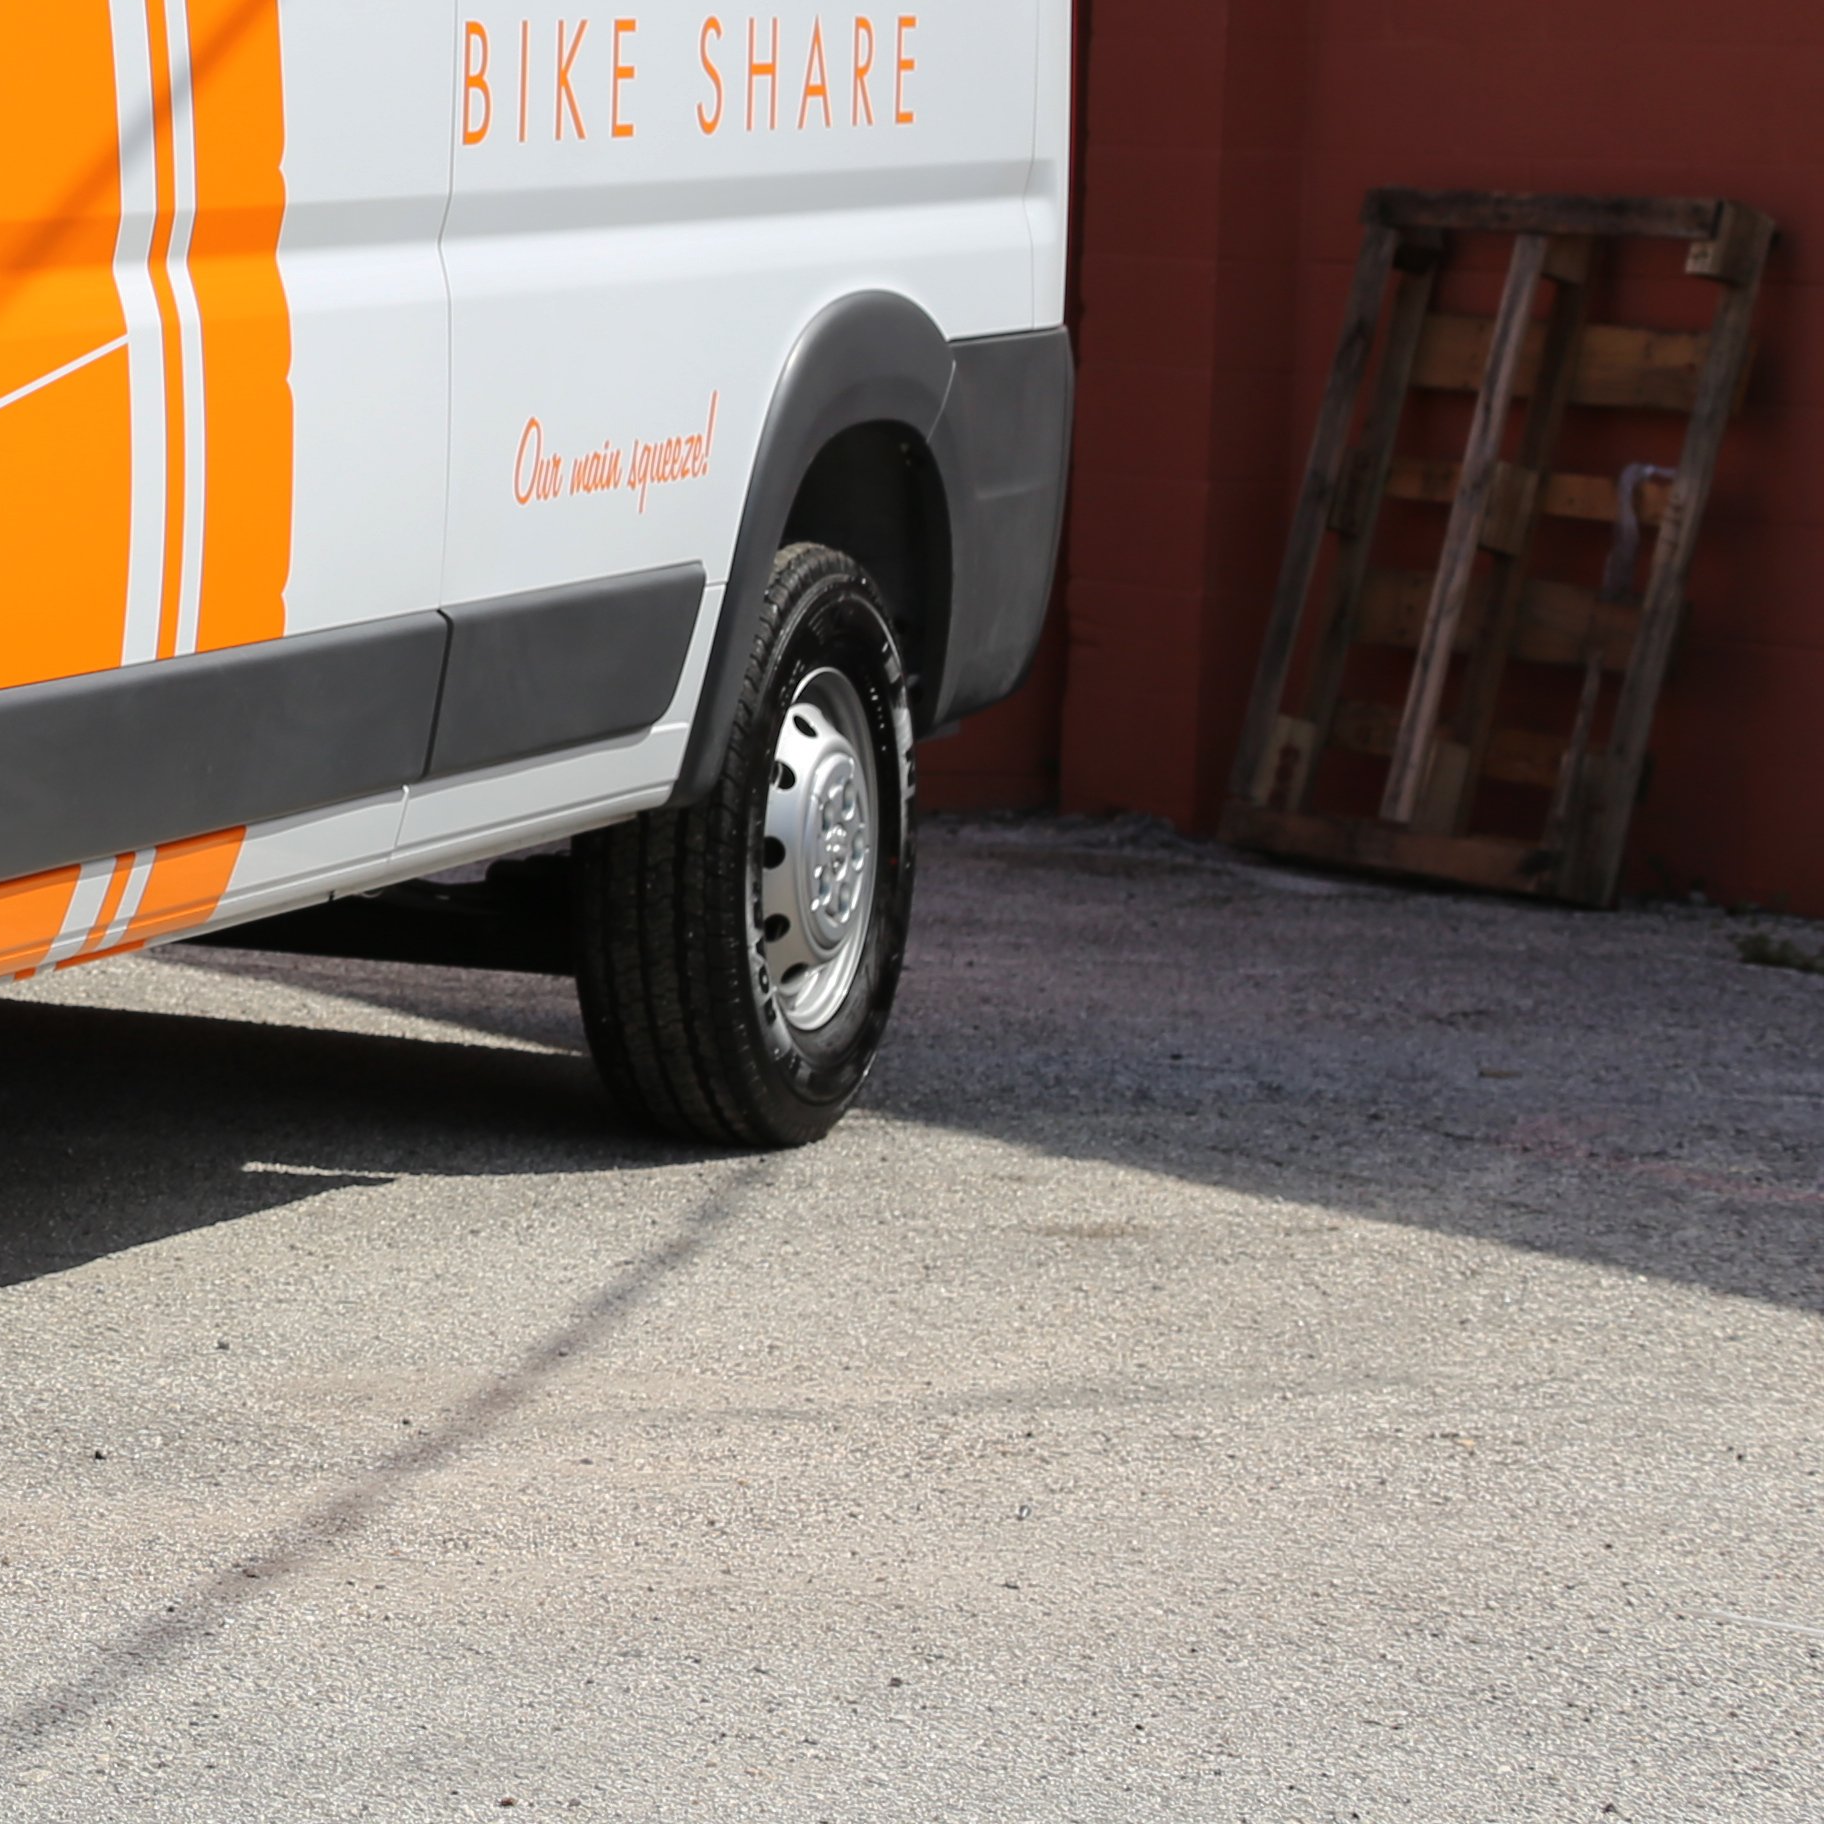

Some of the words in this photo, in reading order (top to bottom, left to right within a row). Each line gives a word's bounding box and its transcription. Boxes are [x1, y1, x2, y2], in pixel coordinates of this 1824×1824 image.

[461, 17, 639, 147] BIKE
[696, 14, 919, 136] SHARE
[512, 415, 564, 506] Our
[568, 440, 624, 497] main
[626, 389, 721, 514] squeeze!
